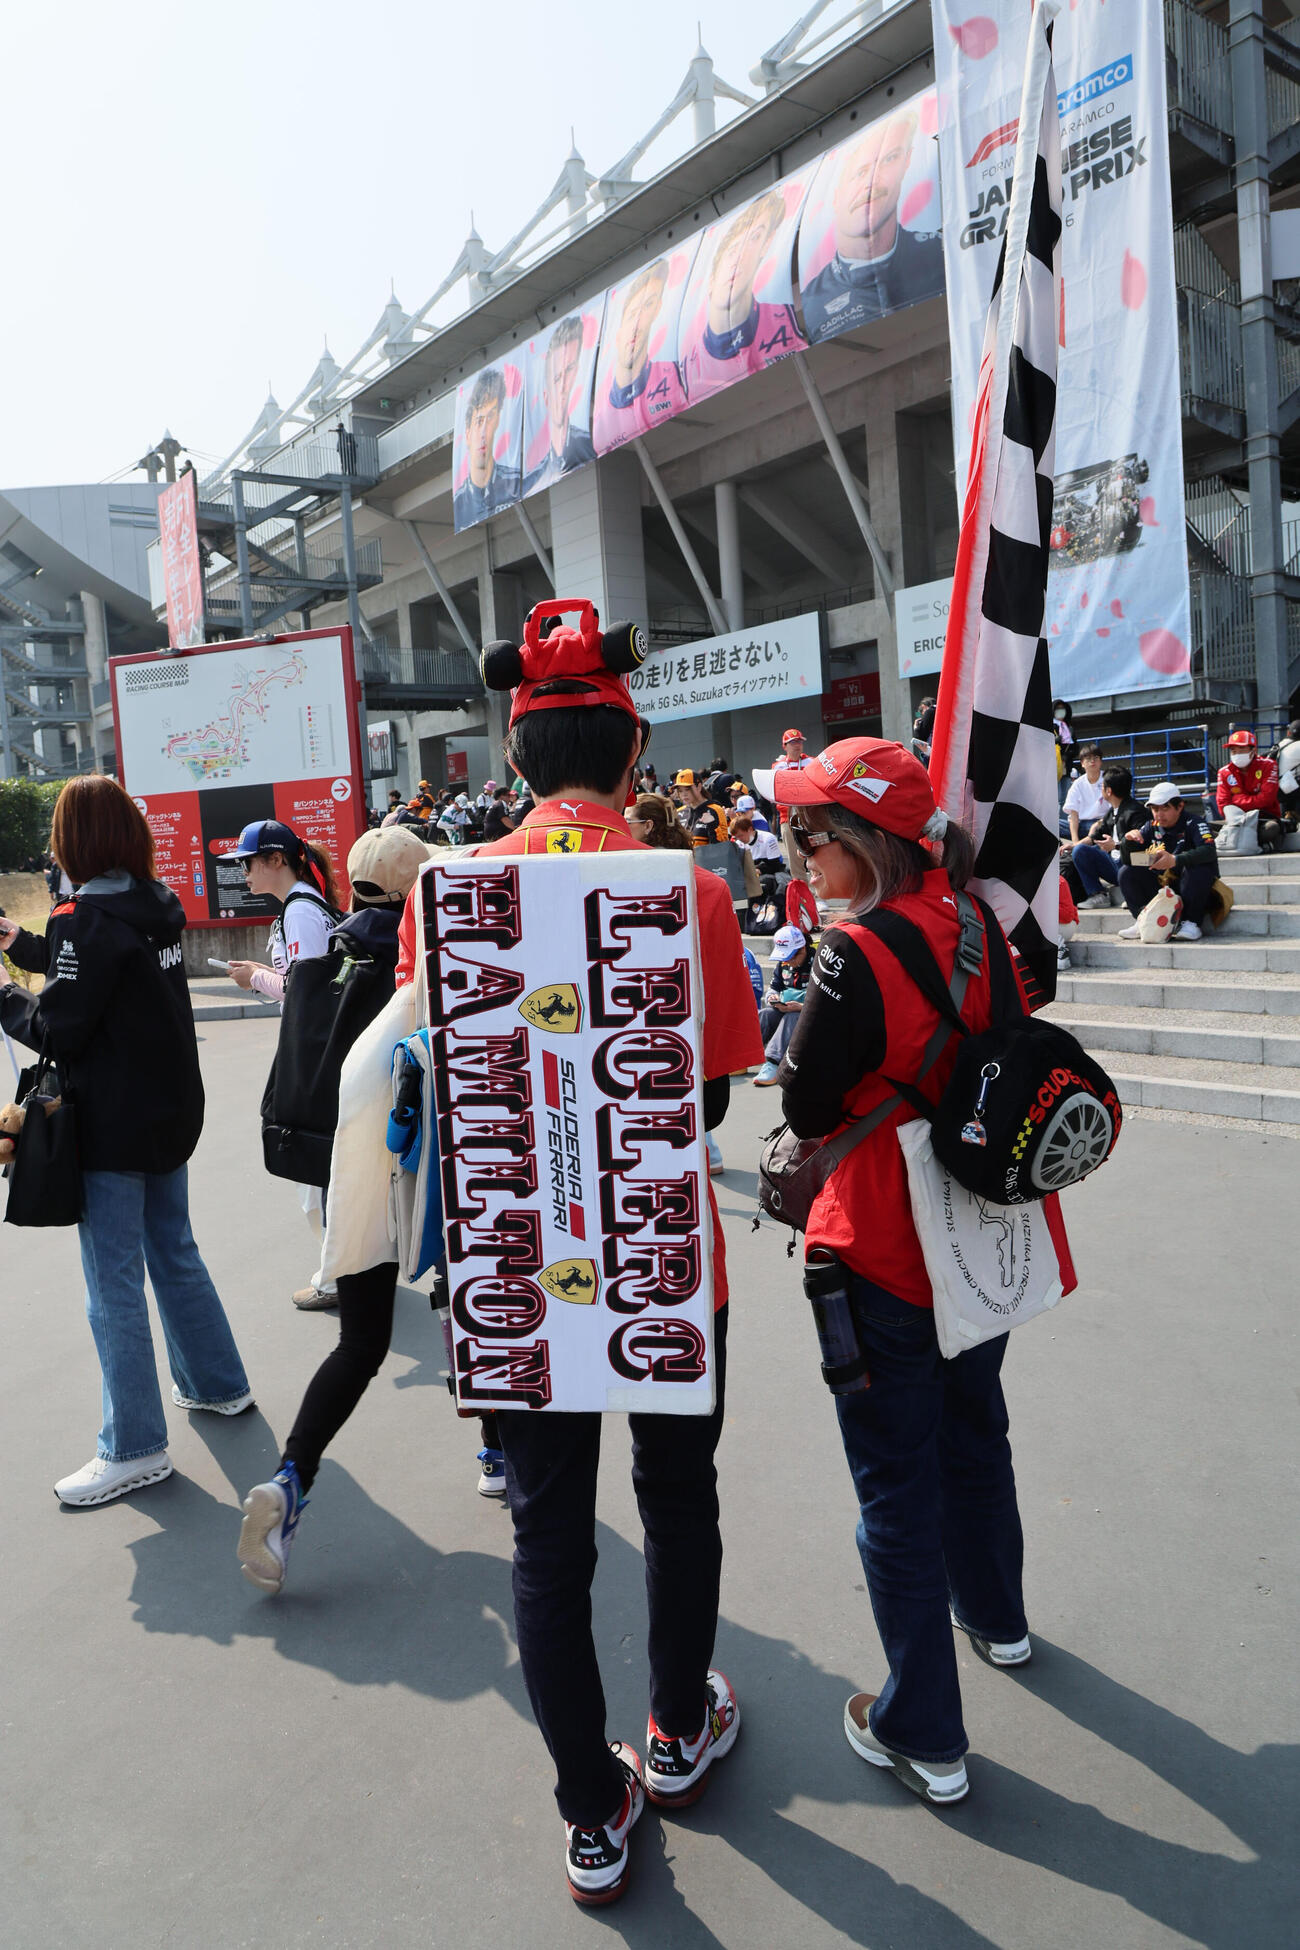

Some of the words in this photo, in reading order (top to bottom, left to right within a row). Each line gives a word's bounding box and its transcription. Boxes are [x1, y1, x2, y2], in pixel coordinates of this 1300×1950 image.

[1060, 102, 1115, 138] ARAMCO
[1070, 136, 1148, 202] PRIX
[820, 304, 864, 332] CADILLAC
[914, 635, 946, 653] ERIC
[630, 640, 789, 691] の走りを見逃さない。
[126, 684, 149, 693] RACING
[150, 680, 174, 690] COURSE
[174, 678, 190, 687] MAP
[658, 696, 670, 709] 5G
[820, 945, 845, 971] aws
[819, 982, 842, 1001] MILLE
[422, 864, 553, 1410] HAMILTON
[561, 1057, 583, 1201] SCUDERIA
[584, 885, 706, 1383] LECLERC
[546, 1110, 568, 1233] FERRARI
[1005, 1166, 1019, 1193] 1962
[944, 1181, 956, 1233] SUZUKA
[1021, 1212, 1031, 1262] SUZUKA
[951, 1241, 978, 1289] CIRCUIT
[977, 1288, 1010, 1315] SUZUKA
[651, 1760, 679, 1772] CELL
[576, 1855, 608, 1865] CELL
